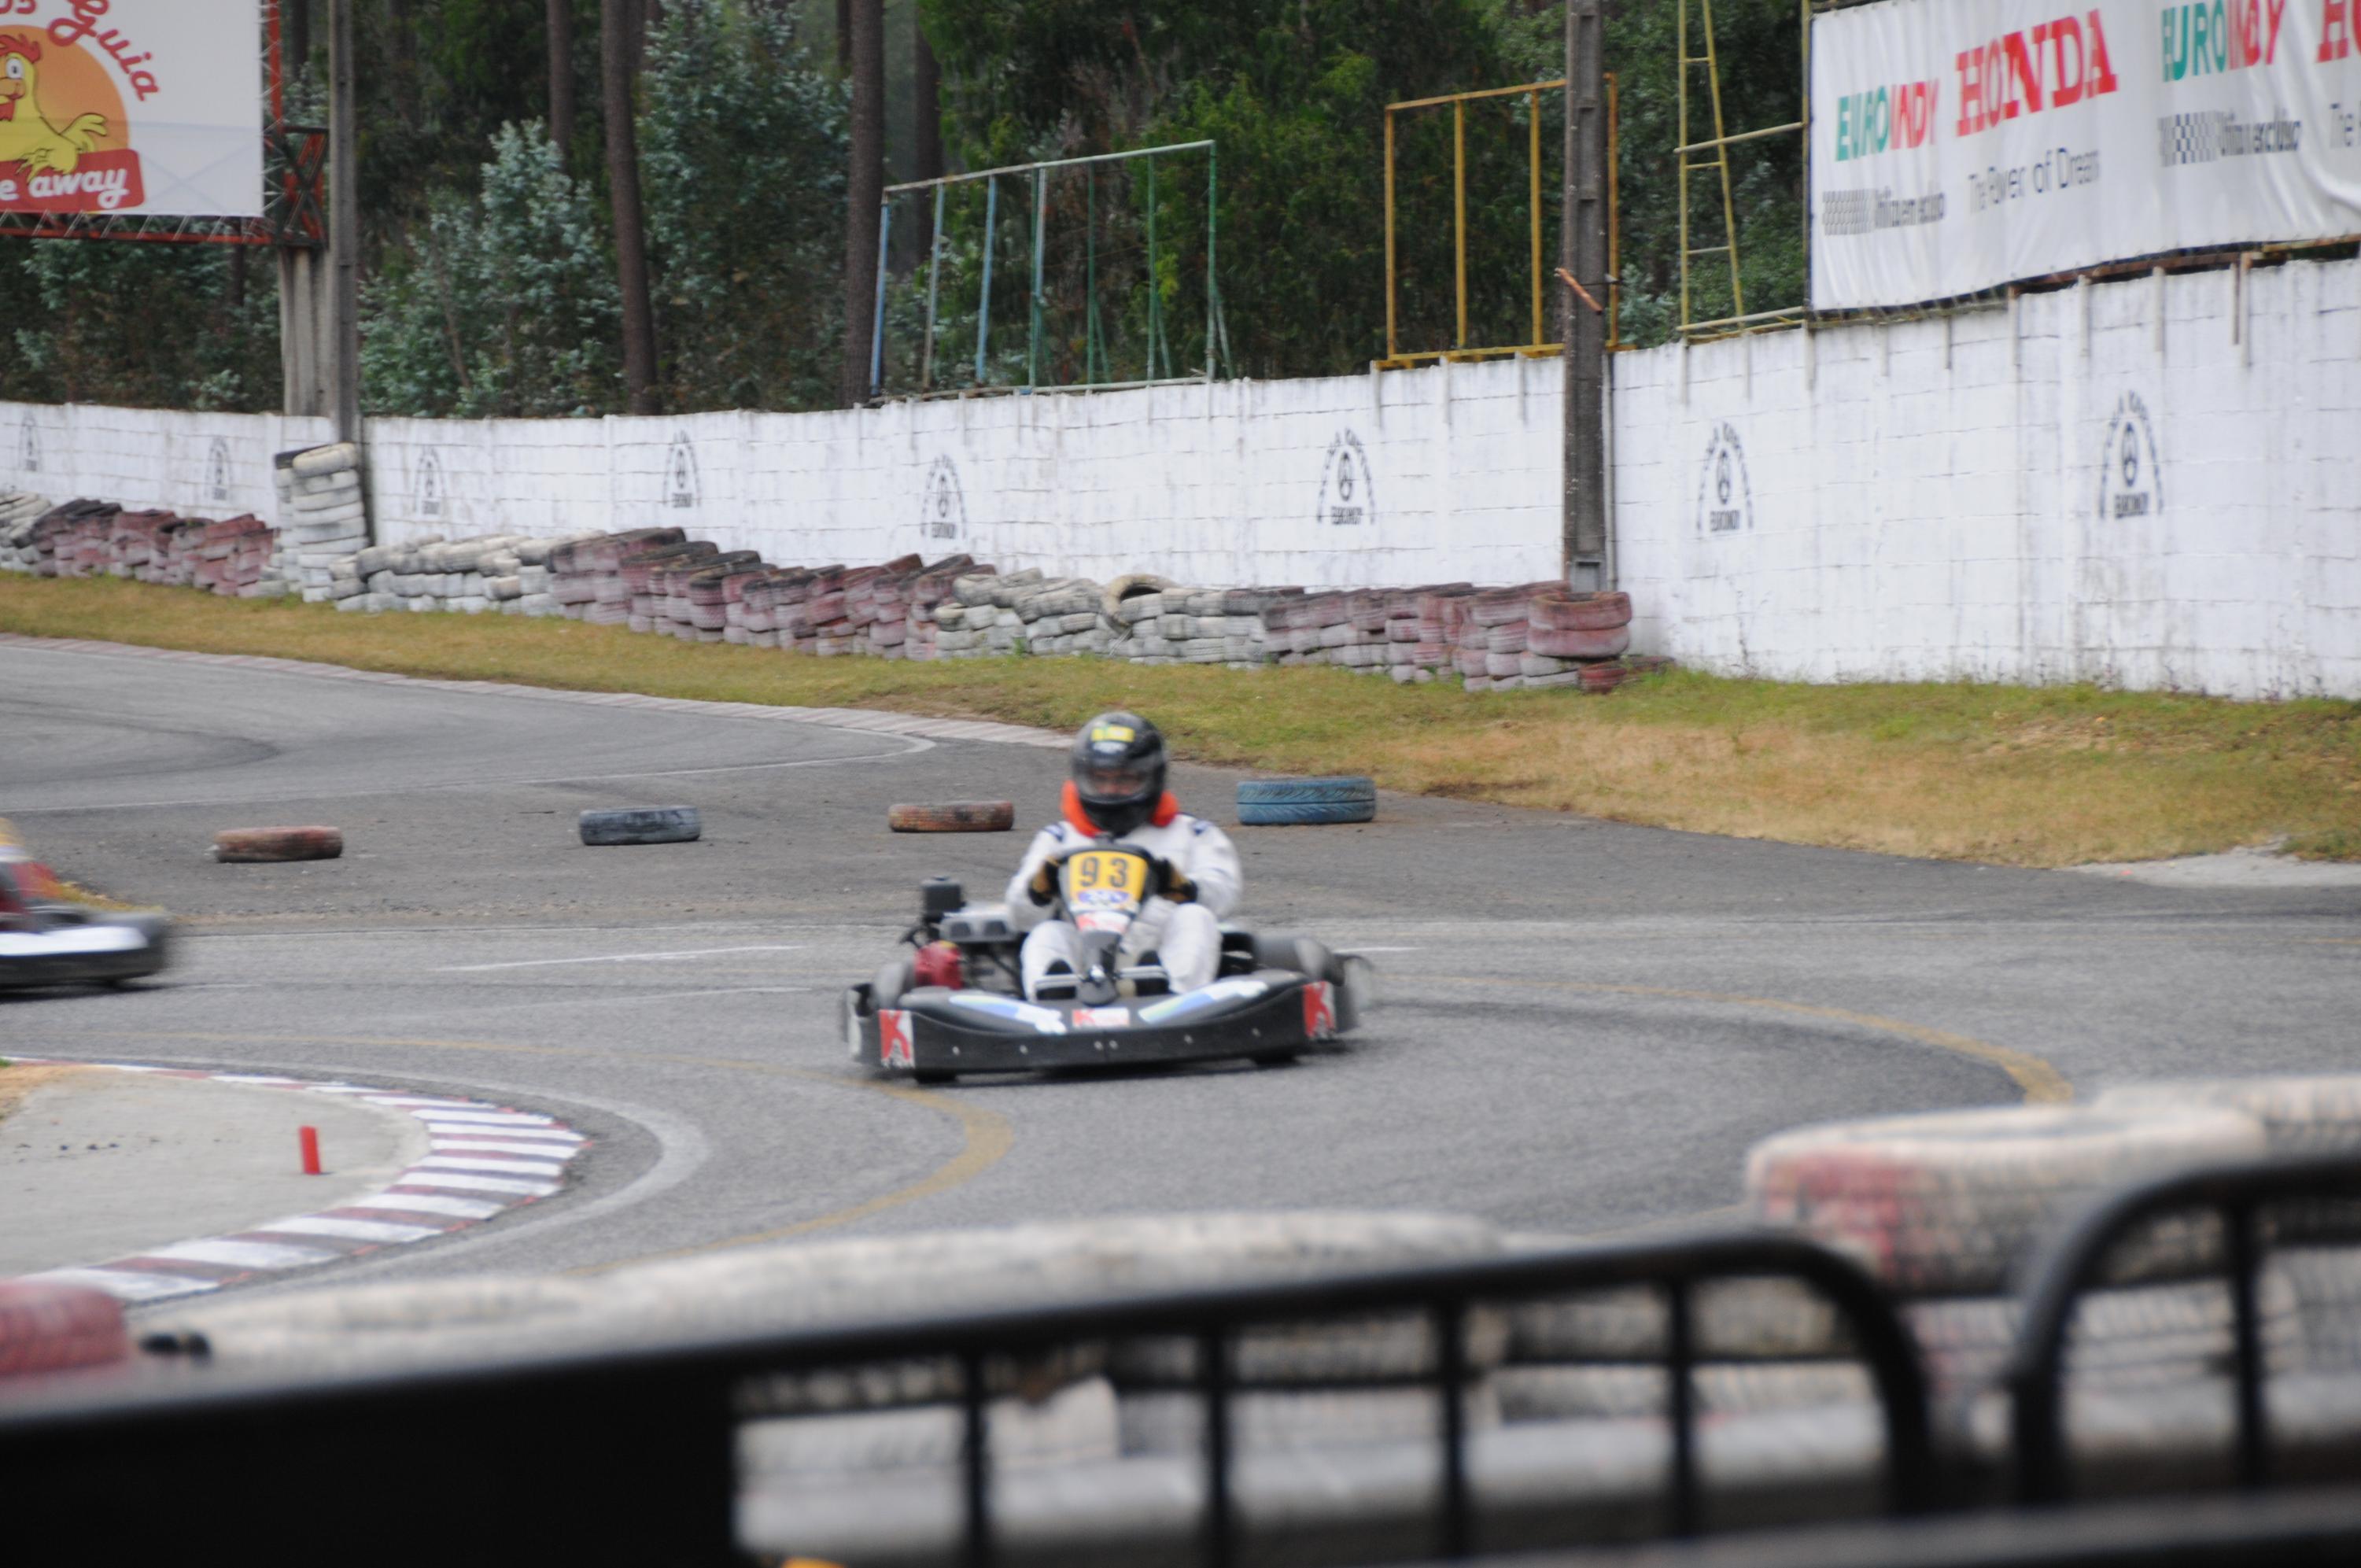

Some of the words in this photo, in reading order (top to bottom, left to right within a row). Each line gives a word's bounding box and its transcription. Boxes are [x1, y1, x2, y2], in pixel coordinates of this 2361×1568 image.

[1955, 8, 2119, 138] HONDA
[1835, 78, 1939, 162] EUROINDY
[28, 168, 130, 209] away
[1079, 856, 1129, 888] 93
